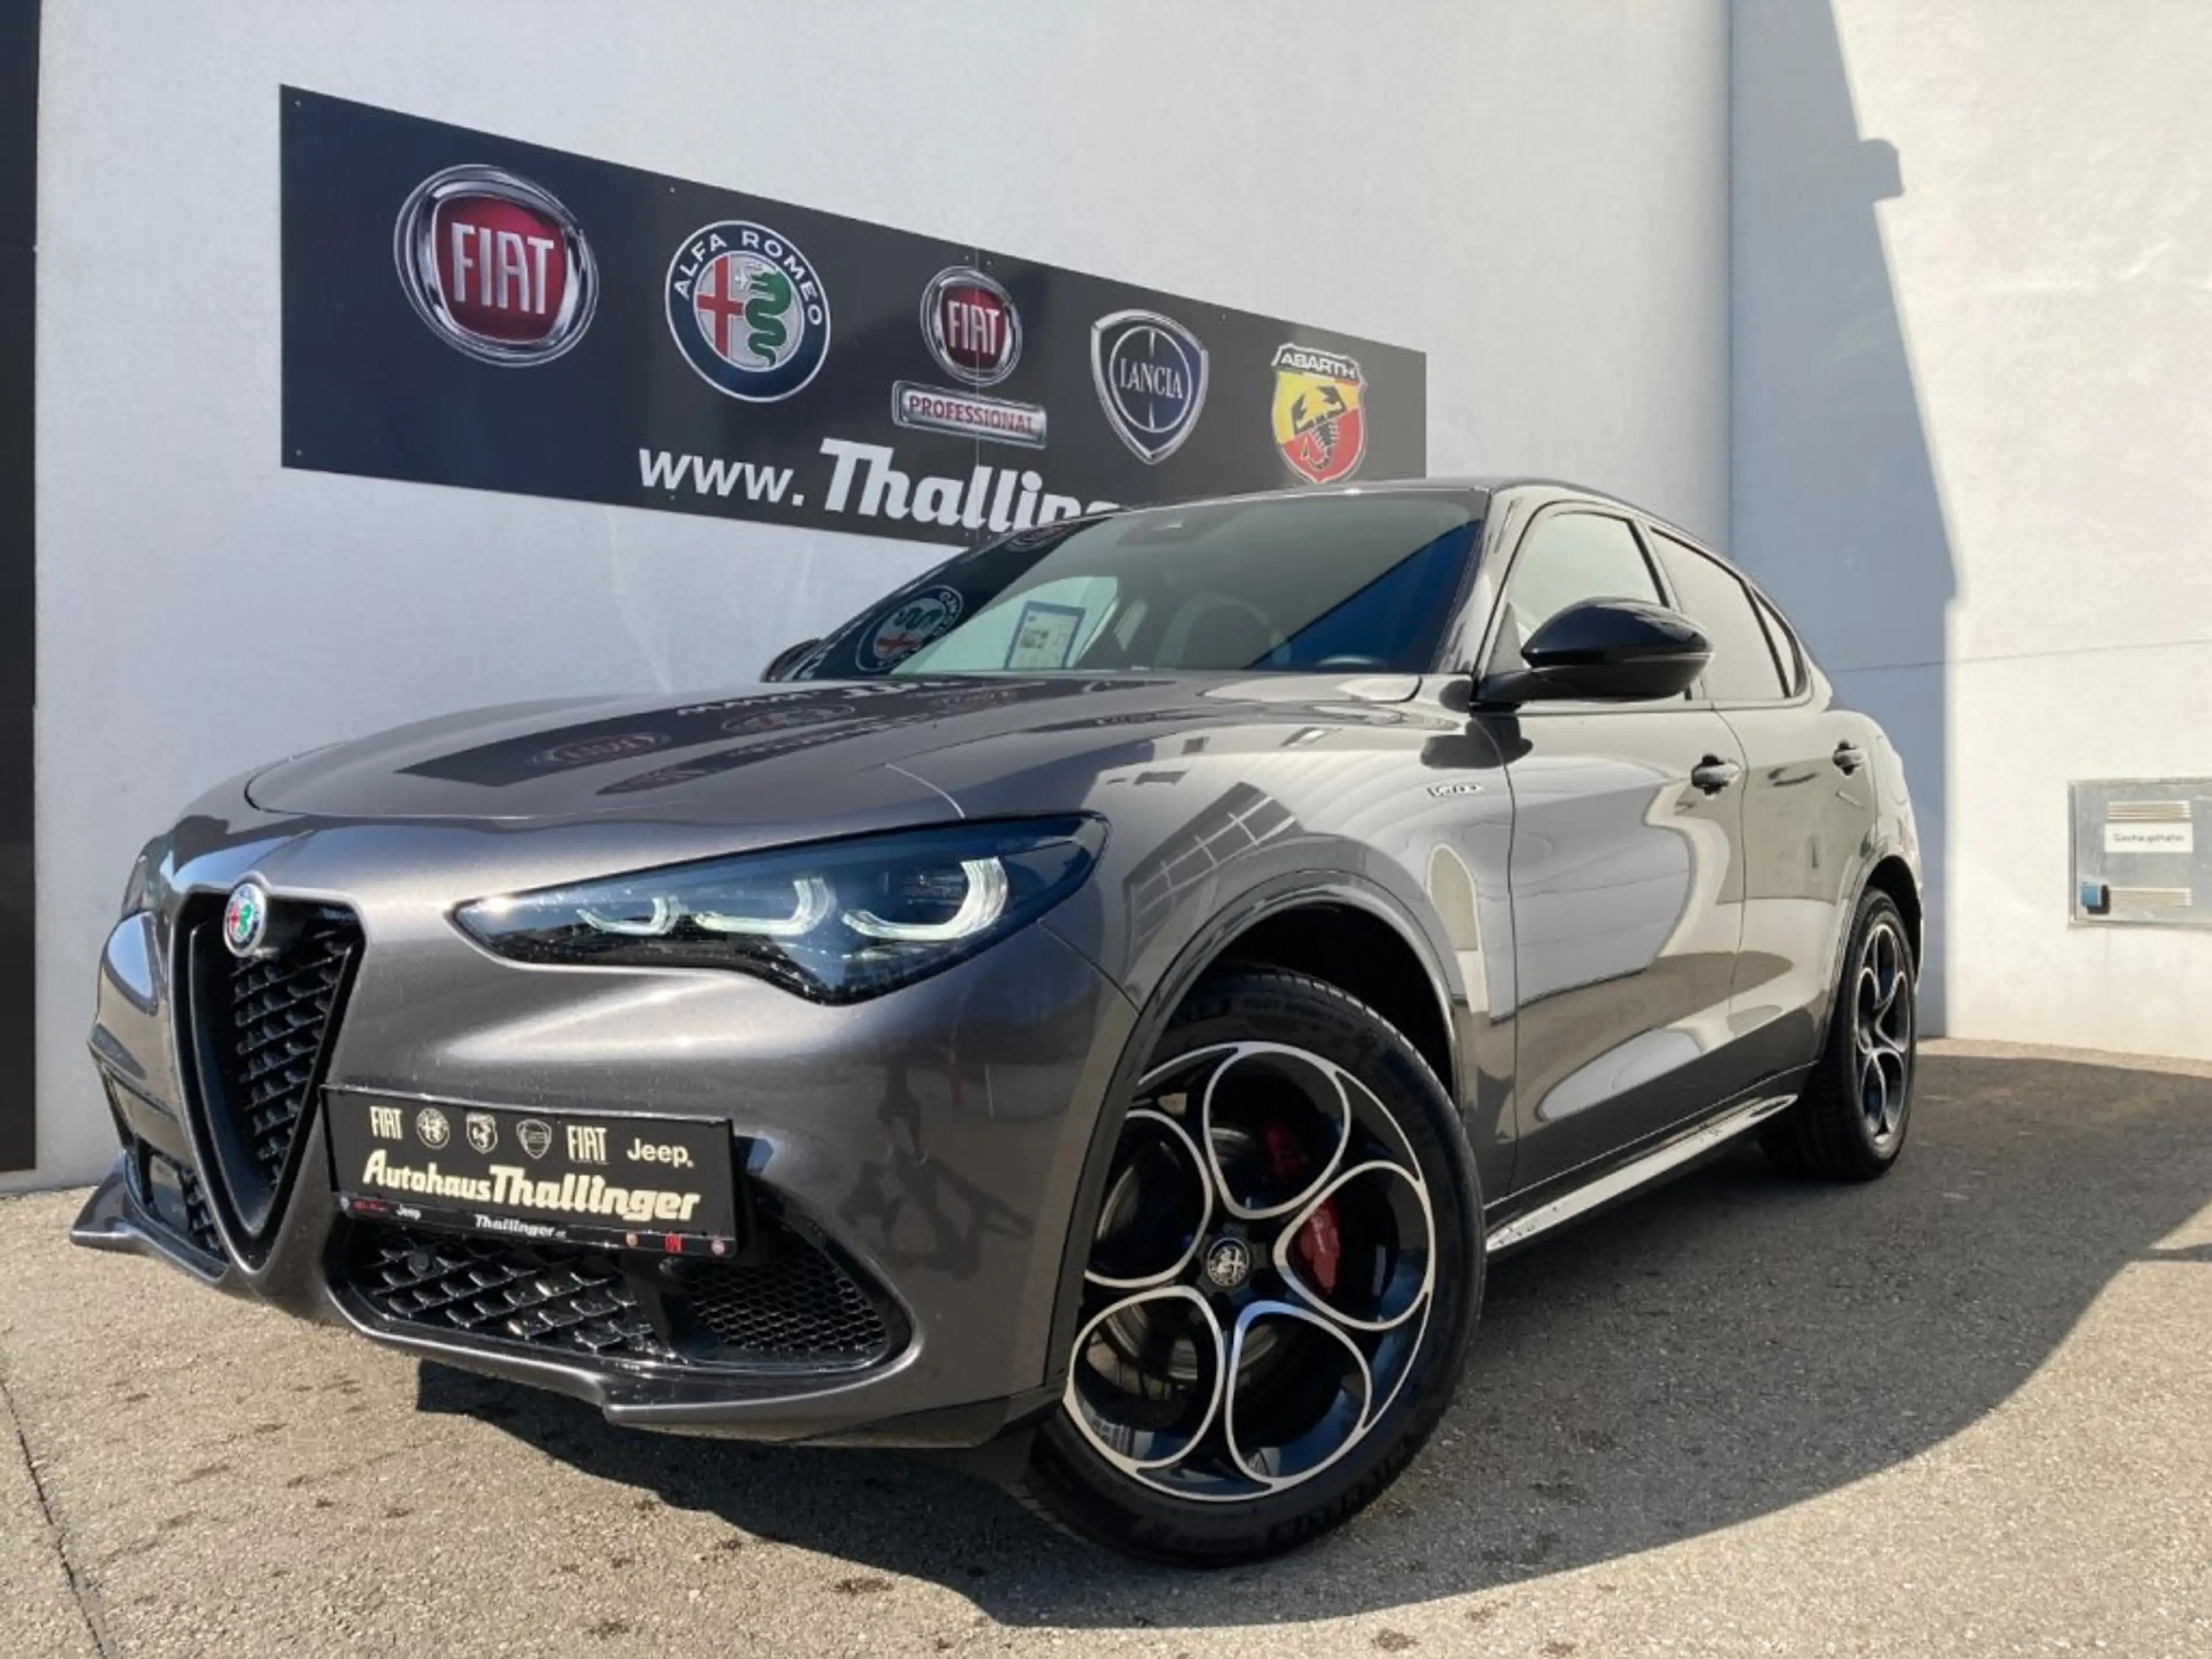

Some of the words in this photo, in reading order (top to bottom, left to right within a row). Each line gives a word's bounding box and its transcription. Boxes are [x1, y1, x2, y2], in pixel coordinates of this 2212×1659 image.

[451, 222, 554, 315] FIAT
[674, 232, 728, 300] ALFA
[742, 230, 822, 325] ROMEO
[947, 302, 1001, 355] FIAT
[1120, 358, 1184, 399] LANCIA
[1280, 352, 1356, 378] ABARTH
[908, 397, 1037, 433] PROFESSIONAL
[820, 438, 1122, 532] Thallin
[369, 1106, 403, 1139] FIAT
[566, 1126, 607, 1161] FIAT
